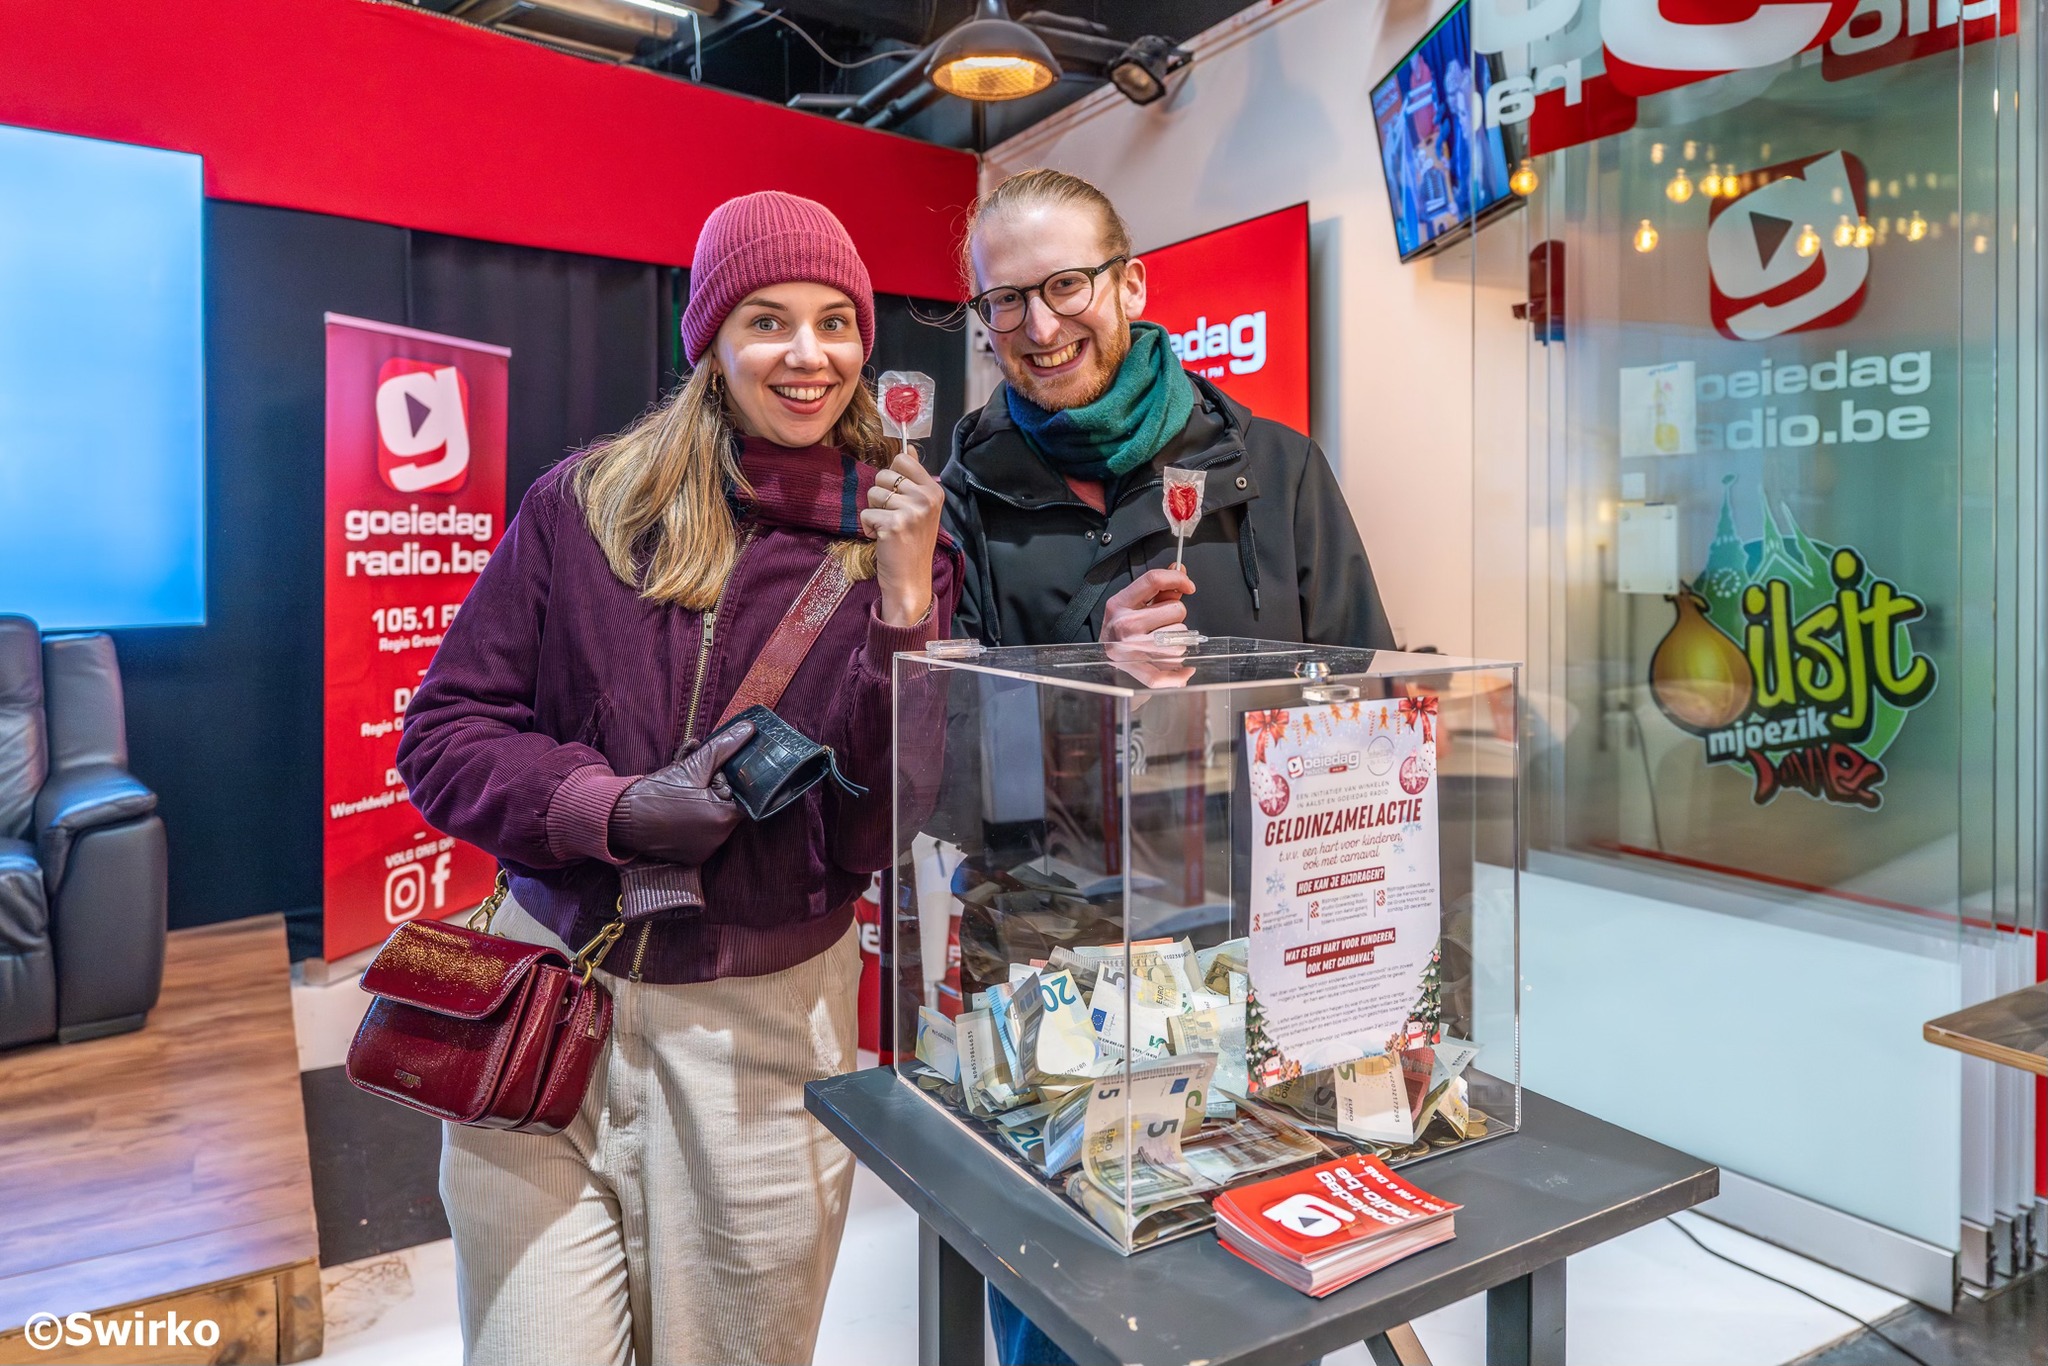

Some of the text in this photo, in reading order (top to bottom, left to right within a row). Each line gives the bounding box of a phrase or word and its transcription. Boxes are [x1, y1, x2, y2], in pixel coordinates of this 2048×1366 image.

[1696, 350, 1931, 402] oeiedag
[1696, 400, 1931, 451] adio.be
[345, 503, 493, 541] goeiedag
[346, 542, 492, 577] radio.be
[372, 605, 435, 634] 105.1
[379, 636, 410, 654] Regio
[1296, 791, 1309, 801] EEN
[1344, 785, 1356, 793] VAN
[1306, 798, 1325, 807] AALST
[1327, 796, 1336, 804] EN
[1337, 792, 1368, 802] GOEIEDAG
[1370, 788, 1389, 797] RADIO
[1265, 798, 1423, 847] GELDINZAMELACTIE
[1302, 846, 1317, 858] een
[1319, 840, 1339, 854] hart
[1341, 839, 1360, 850] voor
[1362, 831, 1403, 846] kinderen,
[1303, 845, 1380, 871] ook met carnaval
[1297, 867, 1384, 895] HOE KAN JE BIJDRAGEN?
[1310, 901, 1319, 919] 2
[1376, 889, 1387, 907] 3
[1285, 930, 1395, 962] WAT IS EEN HART VOOR KINDEREN,
[1307, 951, 1374, 975] OOK MET CARNAVAL?
[1315, 1170, 1404, 1225] goeiedag
[1334, 1166, 1420, 1219] radio.be
